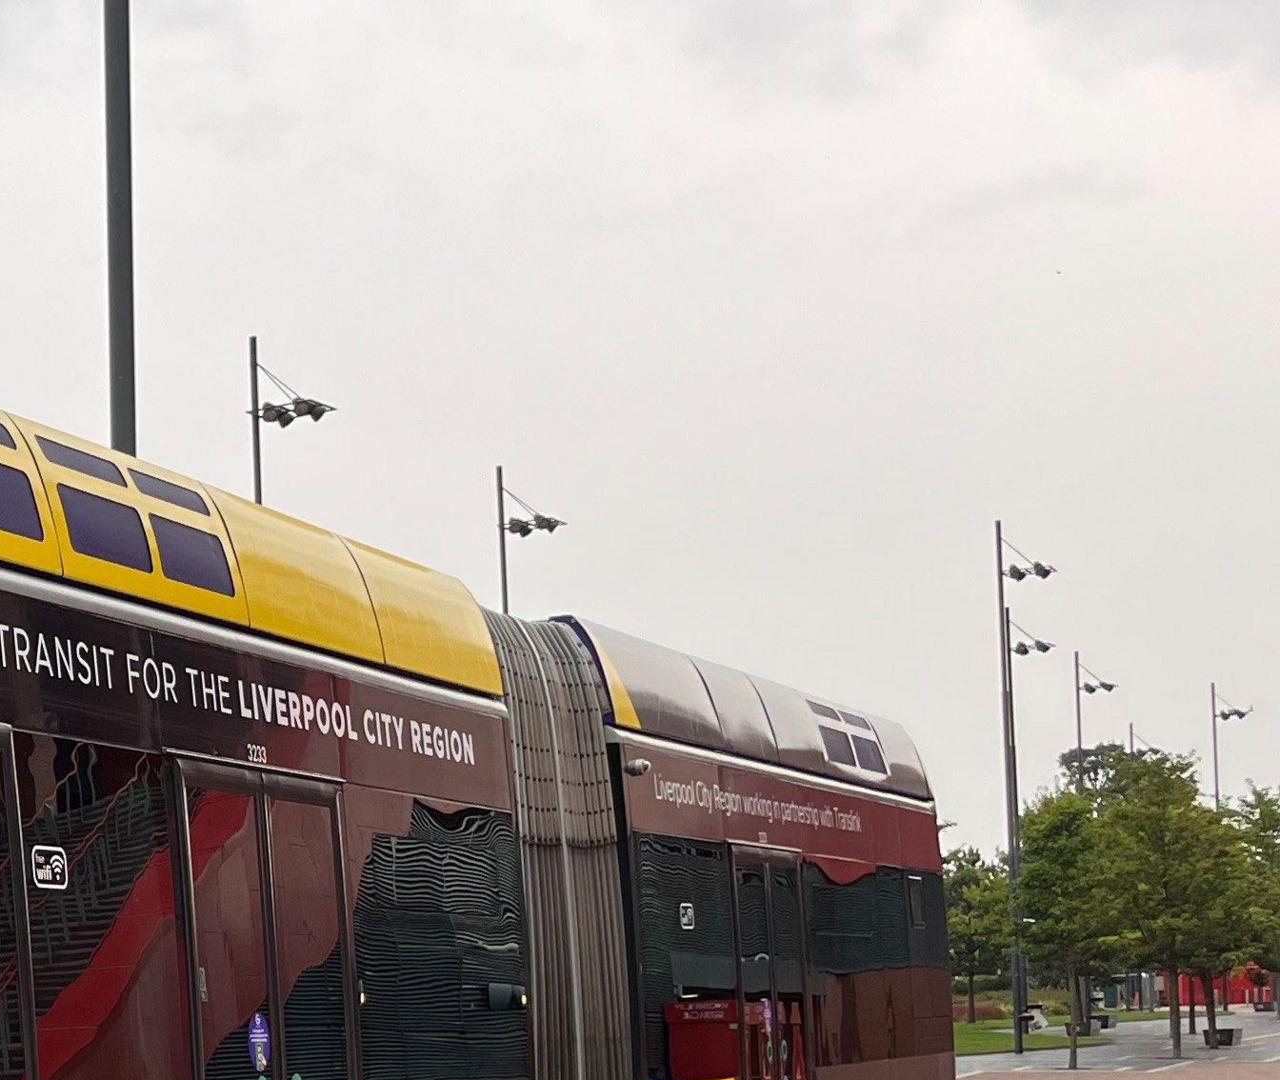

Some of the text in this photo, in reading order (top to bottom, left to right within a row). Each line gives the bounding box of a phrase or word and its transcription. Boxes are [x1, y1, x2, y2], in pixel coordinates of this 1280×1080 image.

[126, 653, 178, 704] FOR
[185, 667, 233, 715] THE
[237, 680, 359, 741] LIVERPOOL
[363, 708, 405, 752] CITY
[409, 719, 475, 766] REGION
[247, 743, 268, 764] 3233
[653, 773, 695, 808] Liverpool
[695, 781, 713, 814] City
[714, 785, 741, 816] Region
[742, 792, 773, 823] working
[36, 864, 52, 881] wifi
